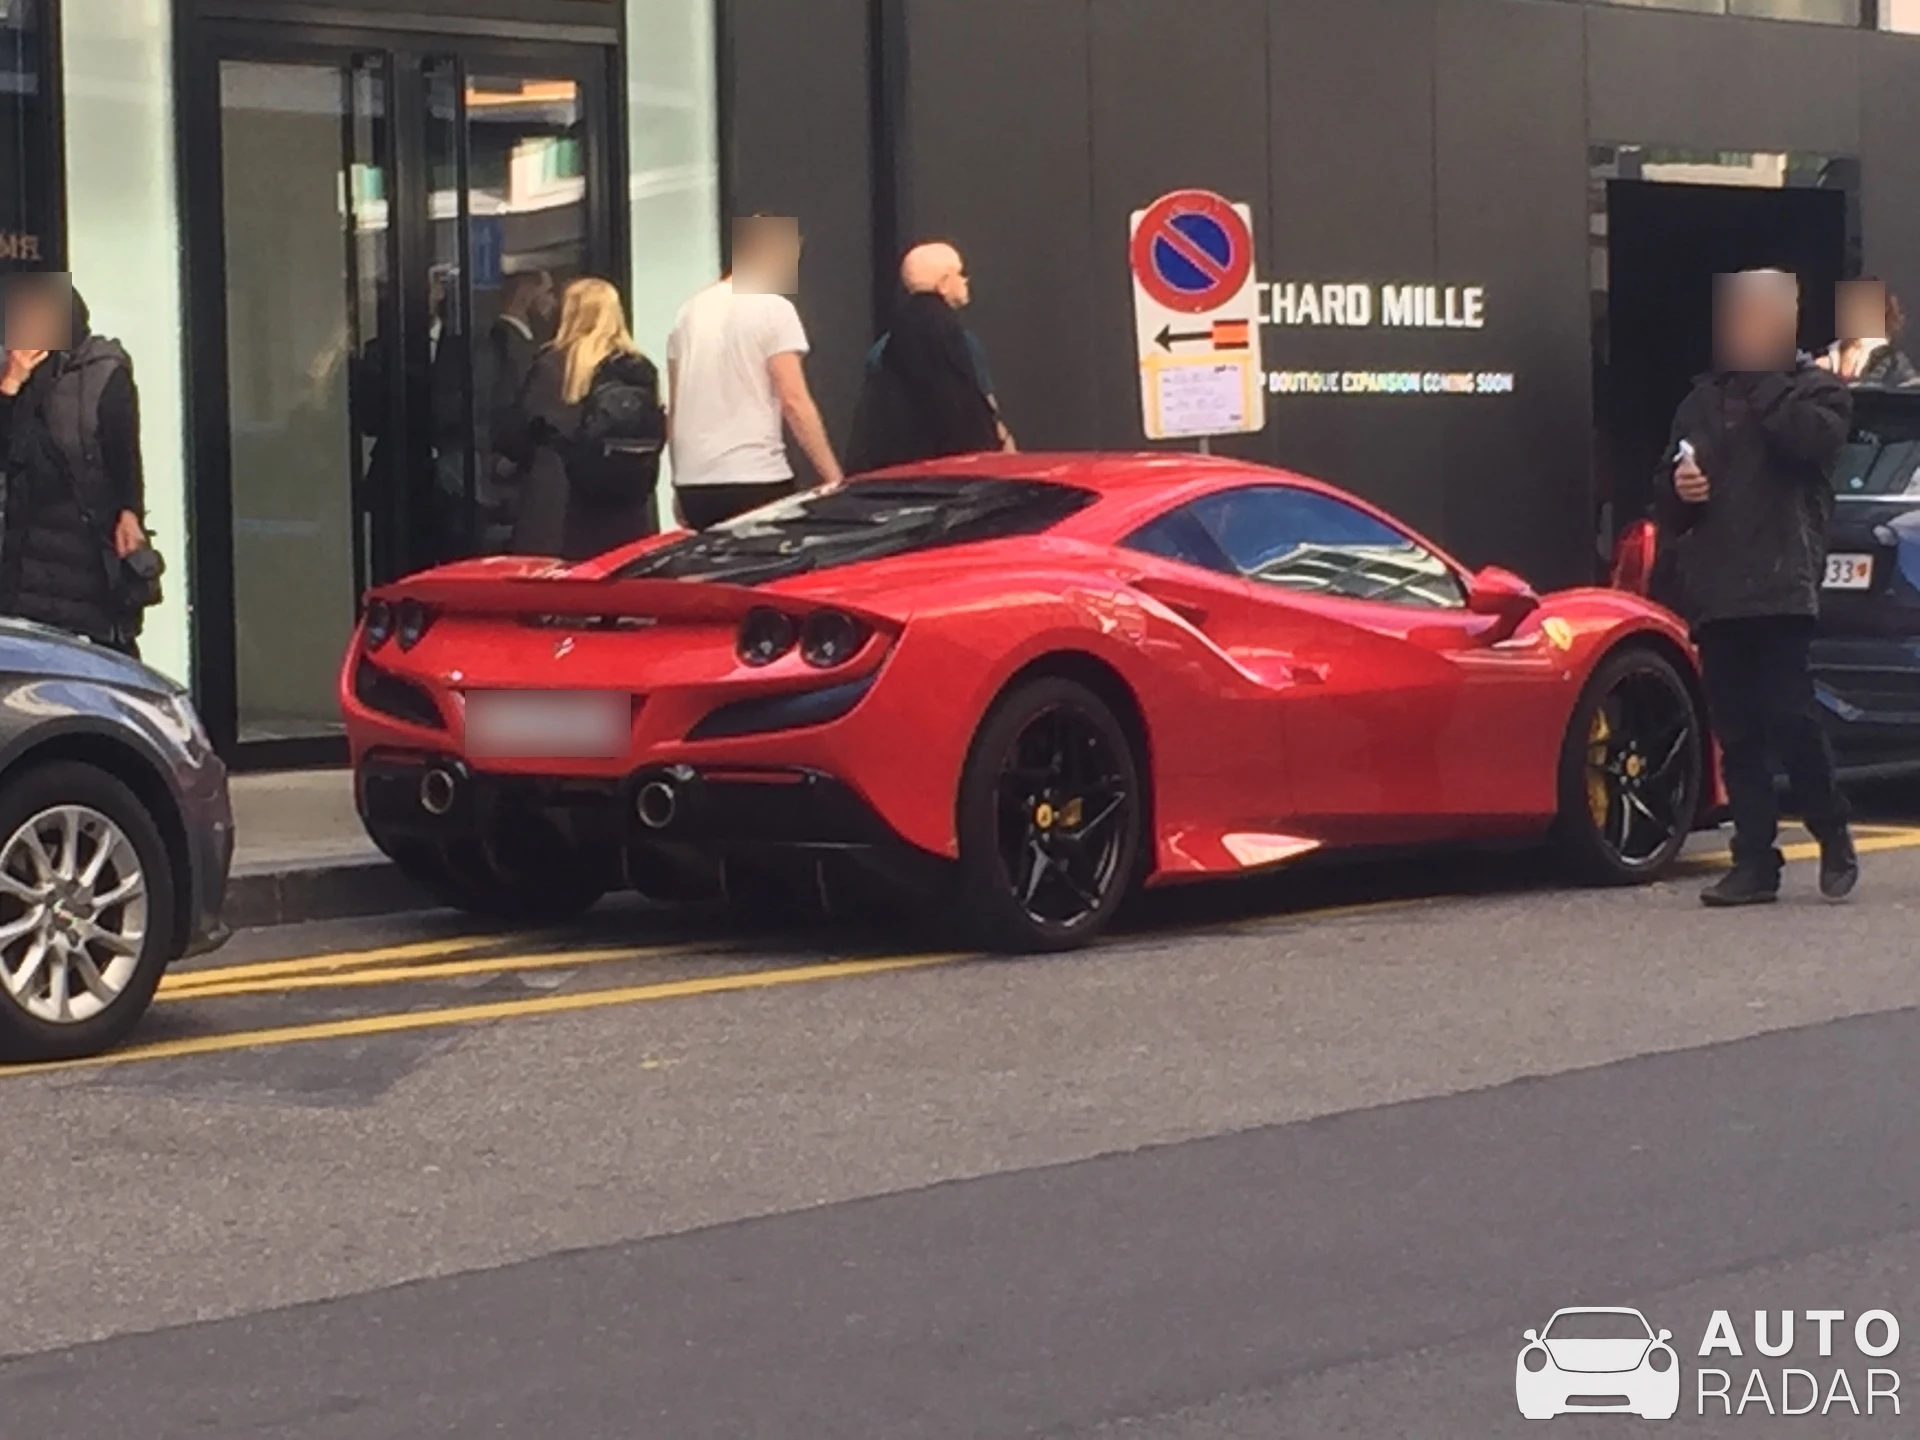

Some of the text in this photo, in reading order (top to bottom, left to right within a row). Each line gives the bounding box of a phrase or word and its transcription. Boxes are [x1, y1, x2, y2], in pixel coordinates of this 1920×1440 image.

[1256, 283, 1484, 328] CHARD MILLE
[1269, 372, 1341, 392] BOUTIQUE
[1342, 372, 1420, 392] EXPANSION
[1423, 373, 1475, 393] COMING
[1476, 374, 1514, 393] SOON
[1828, 560, 1853, 583] 33
